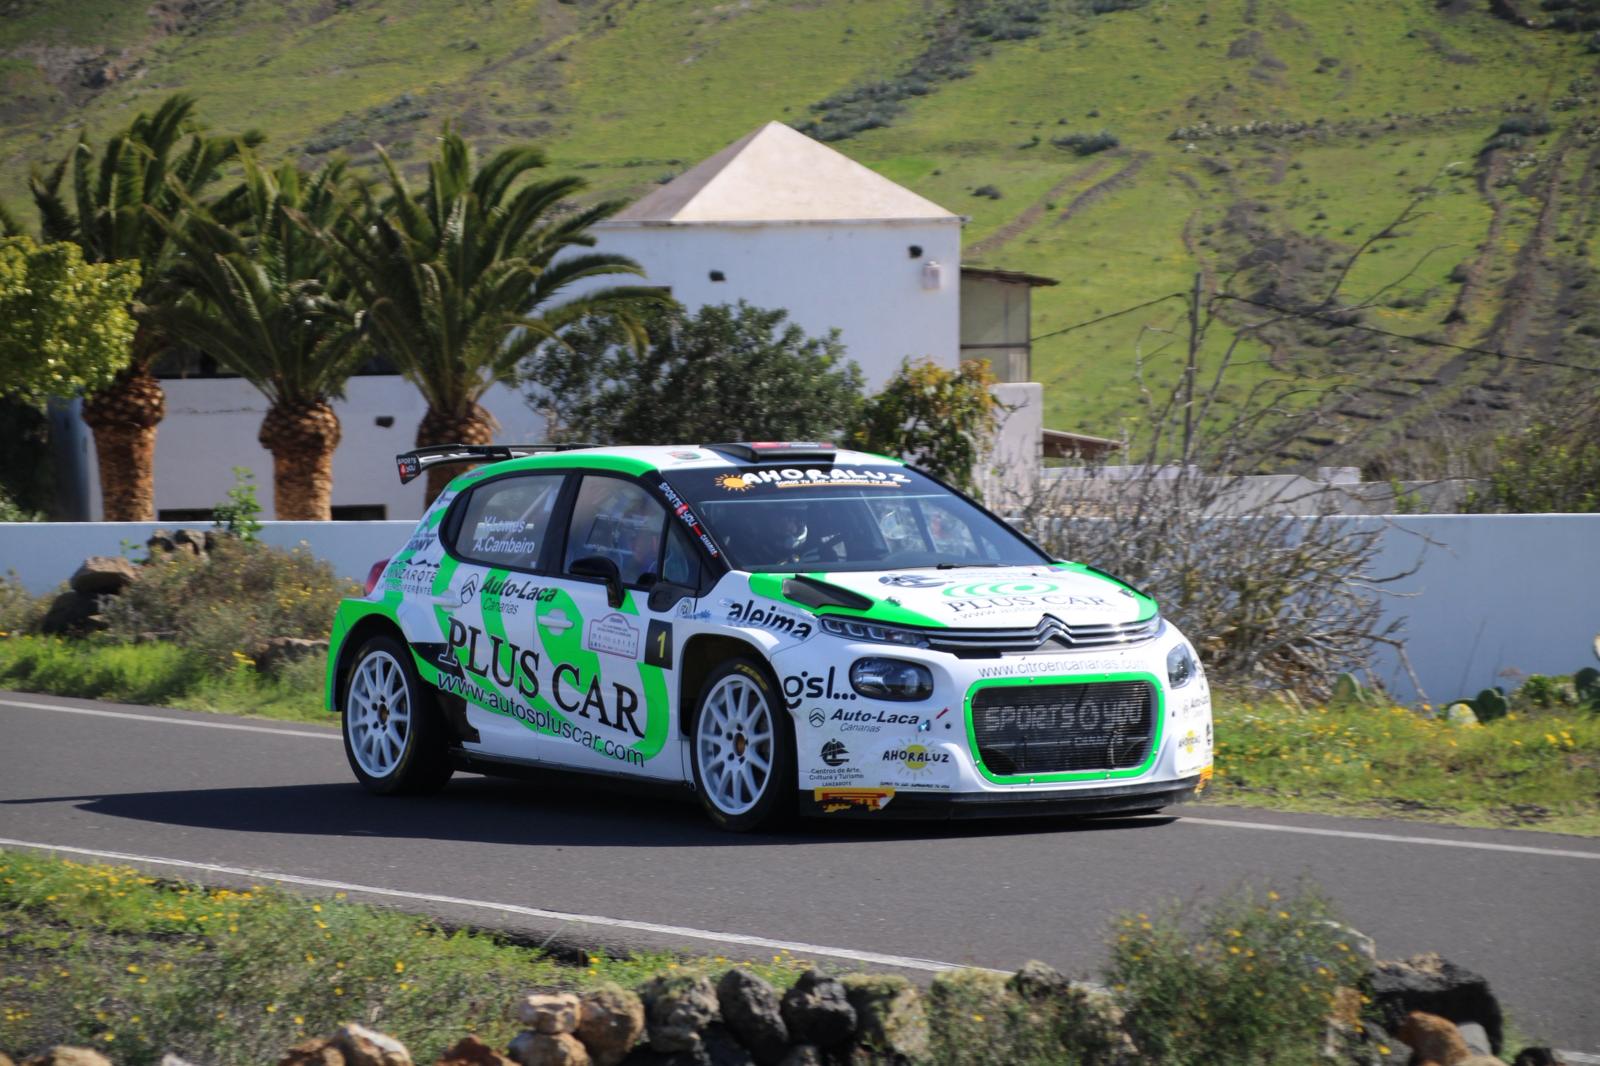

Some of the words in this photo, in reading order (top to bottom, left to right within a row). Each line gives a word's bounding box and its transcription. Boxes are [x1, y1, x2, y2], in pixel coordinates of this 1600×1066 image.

[742, 468, 912, 485] AHORALUZ
[658, 482, 683, 508] SPORTS
[473, 537, 535, 553] A.Cambeiro
[480, 575, 558, 603] Auto-Laca
[483, 597, 519, 615] Canarias
[947, 596, 1036, 613] PLUS
[1041, 595, 1115, 607] CAR
[727, 599, 812, 641] aleima
[656, 630, 667, 659] 1
[437, 616, 540, 698] PLUS
[552, 663, 646, 739] CAR
[978, 659, 1149, 678] www.citroencanarias.com
[436, 671, 645, 768] www.autospluscar.com
[830, 708, 920, 725] Auto-Laca
[985, 703, 1077, 731] SPORTS
[840, 722, 881, 733] Canarias
[882, 750, 950, 763] AHORALUZ
